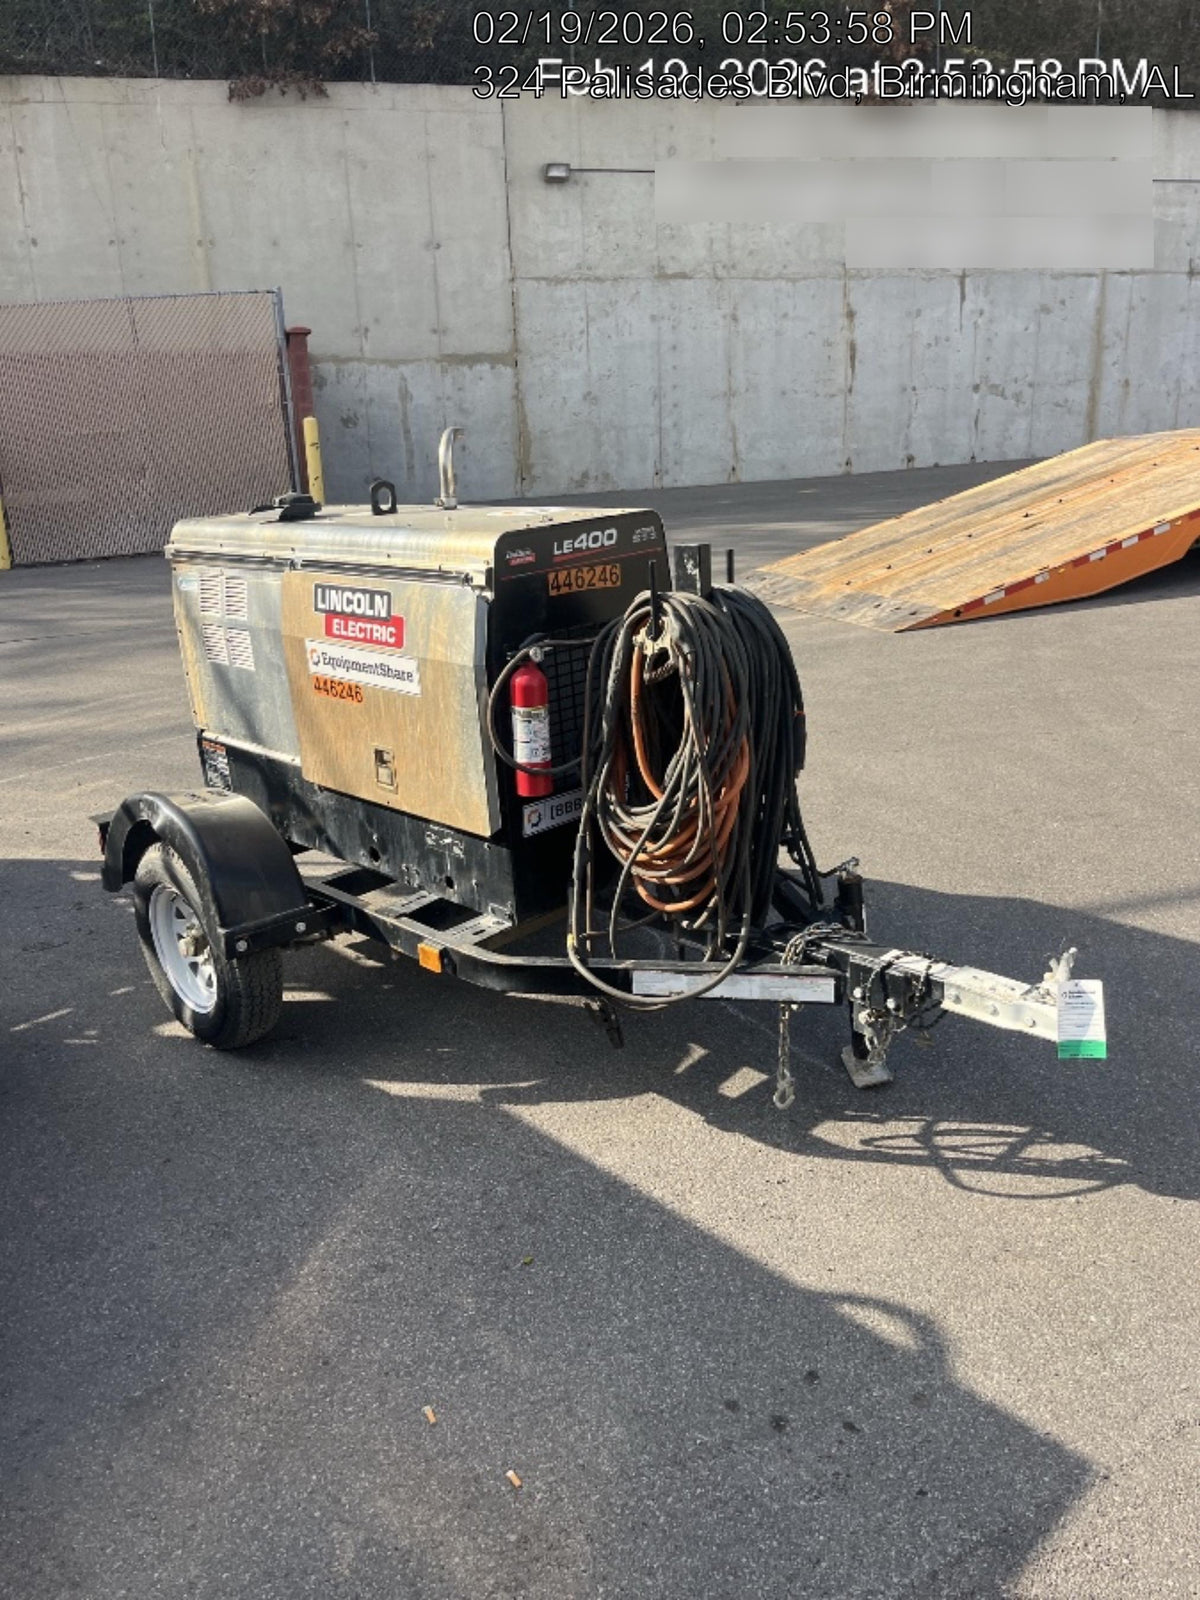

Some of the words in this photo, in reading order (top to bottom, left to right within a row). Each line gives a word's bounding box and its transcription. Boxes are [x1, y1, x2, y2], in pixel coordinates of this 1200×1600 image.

[553, 528, 618, 555] LE400
[549, 564, 620, 594] 446246
[316, 587, 389, 618] LINCOLN
[332, 618, 397, 644] ELECTRIC
[321, 651, 414, 683] EquipmentShare
[313, 676, 364, 704] 446246
